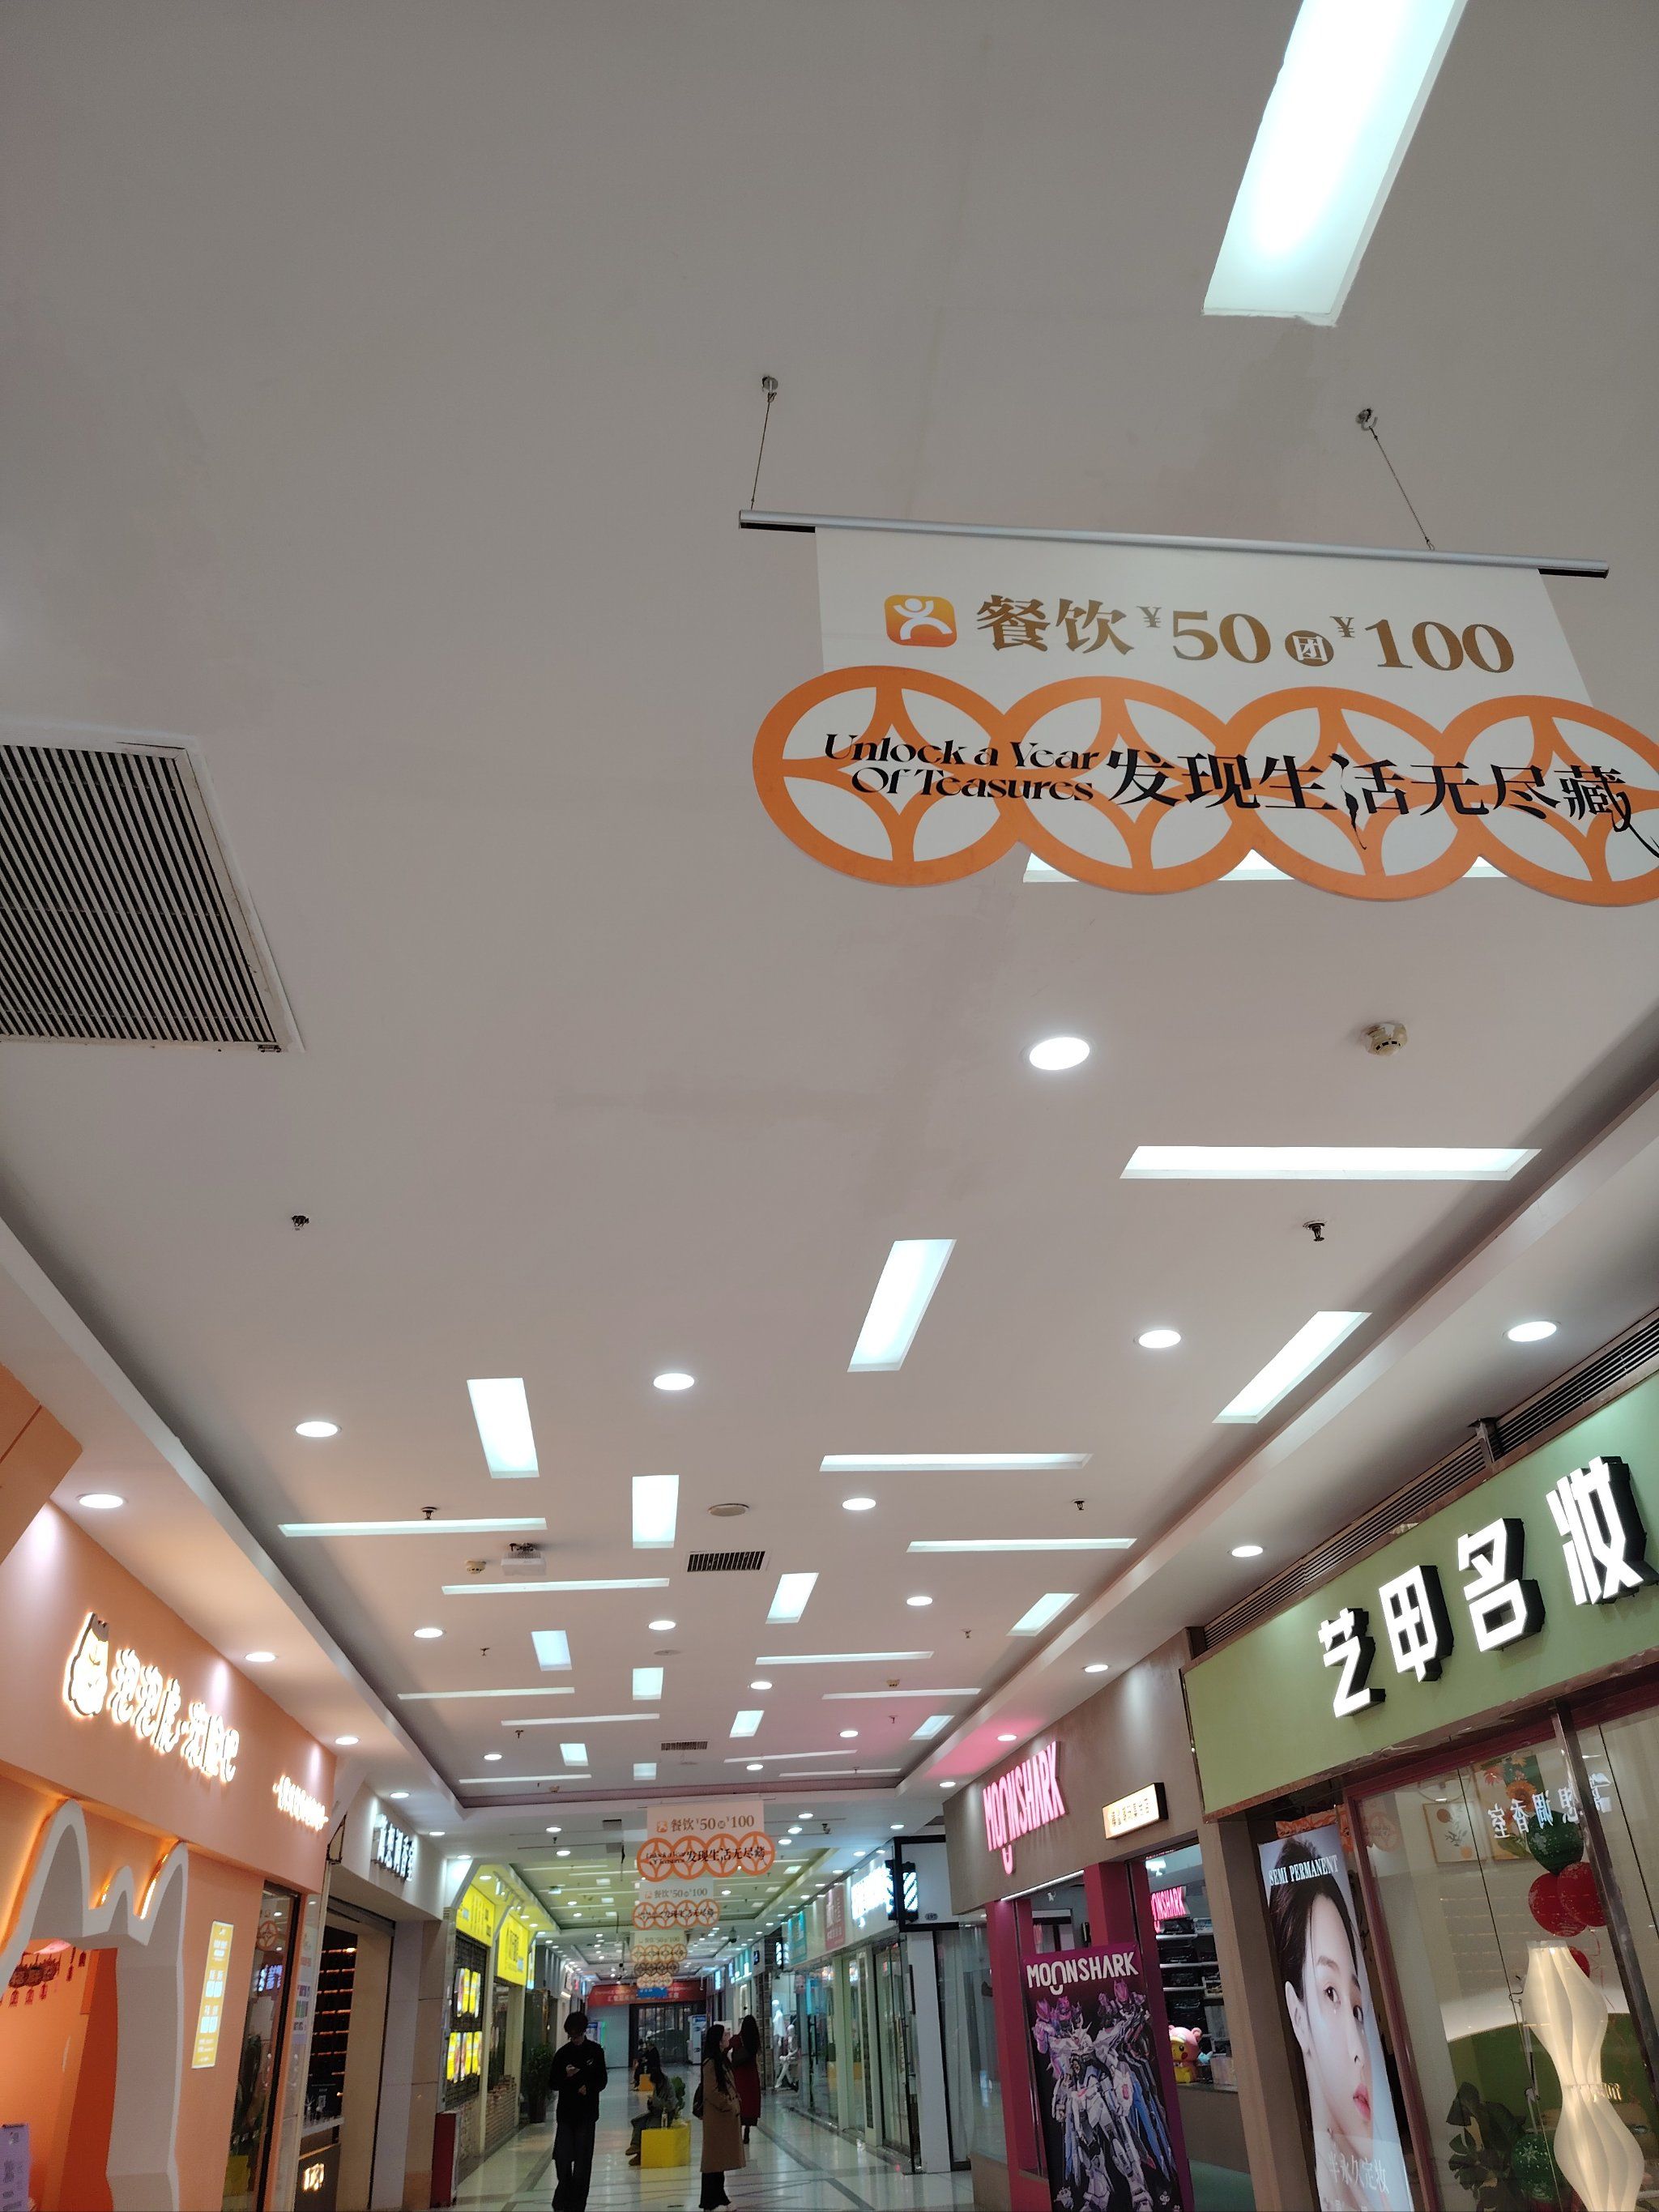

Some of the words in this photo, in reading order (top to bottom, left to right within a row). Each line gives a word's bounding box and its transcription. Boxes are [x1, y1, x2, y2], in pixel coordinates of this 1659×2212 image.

[825, 733, 967, 766] Unlock
[974, 747, 999, 766] a
[1009, 741, 1100, 770] Year
[851, 766, 909, 795] Of
[915, 769, 1094, 802] Teasures
[1106, 747, 1644, 850] 发现生活无尽藏
[1318, 1456, 1644, 1718] 艺甲名妆
[983, 1741, 1066, 1875] MOONSHARK
[1269, 1866, 1288, 1886] SEMI
[1289, 1854, 1339, 1882] PERMANENT
[1026, 1951, 1139, 1996] MOONSHARK
[1328, 2150, 1389, 2194] 半永久定妆
